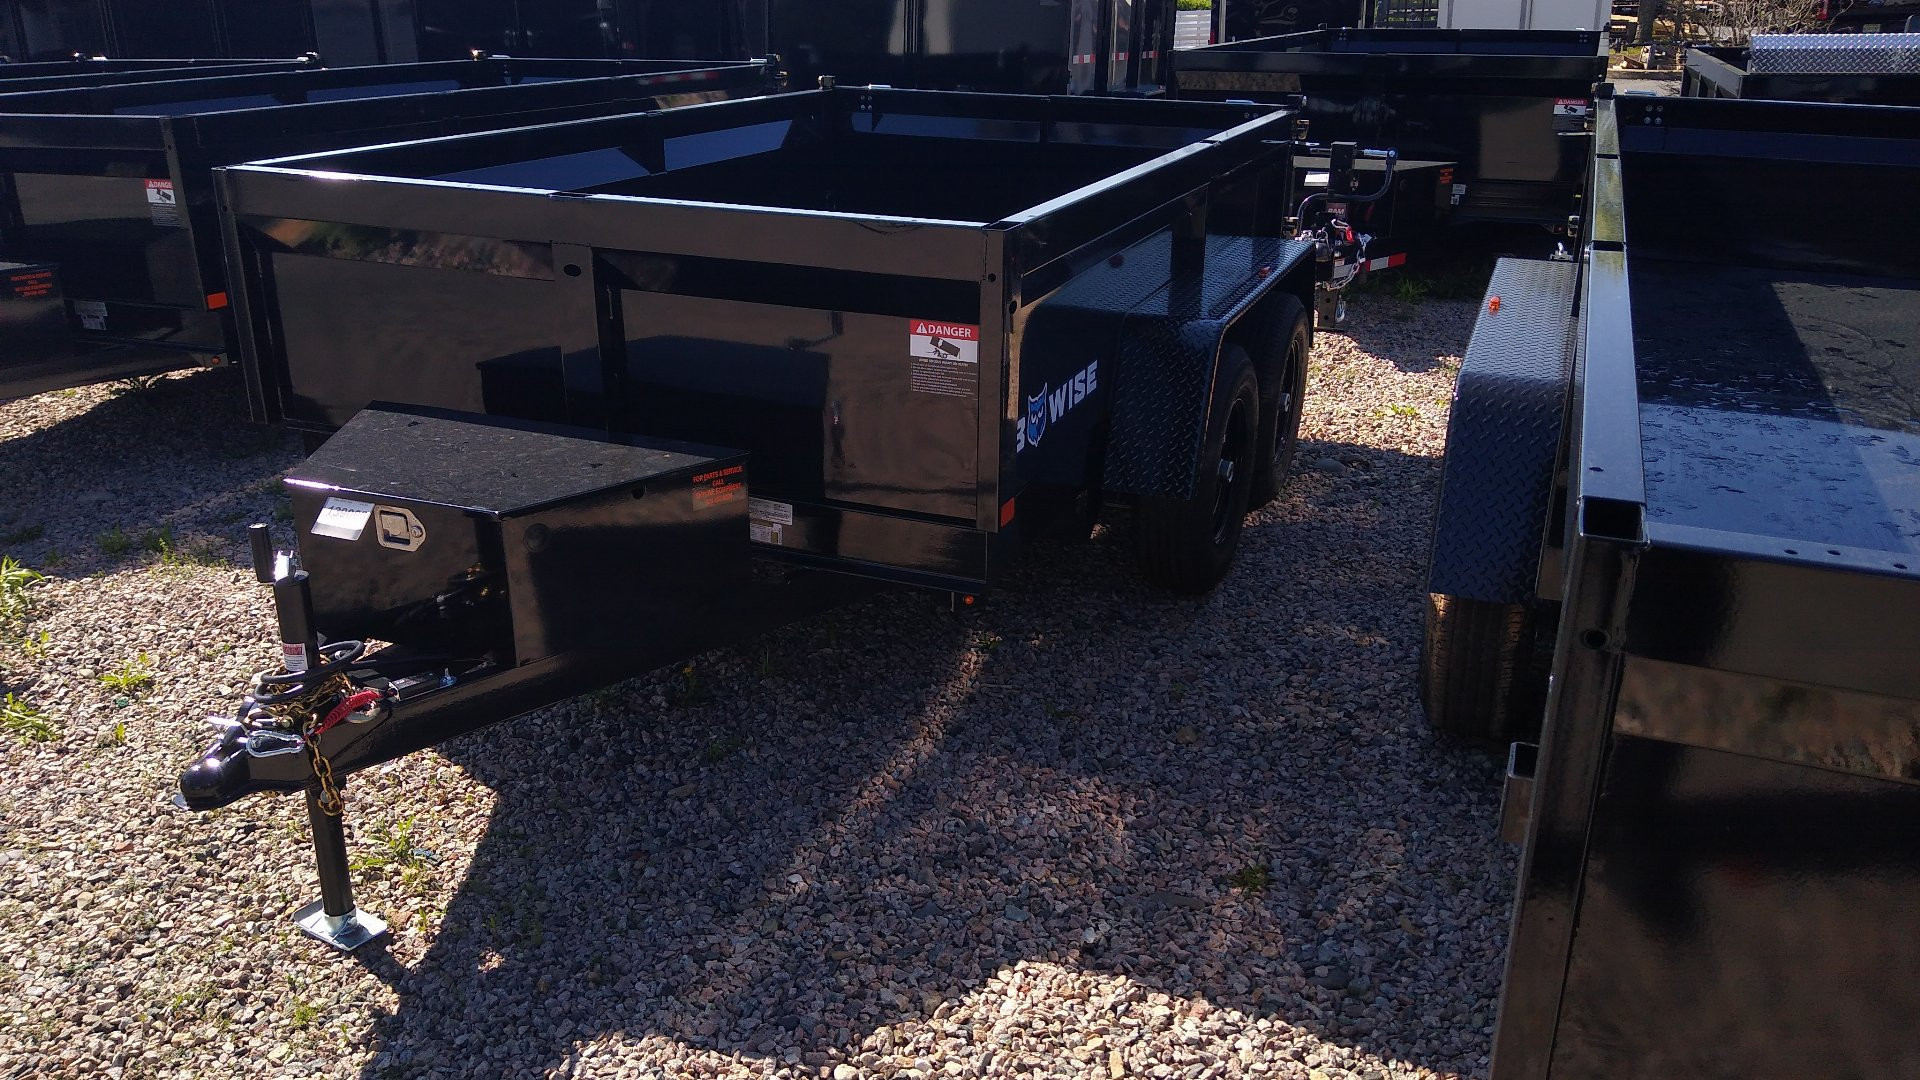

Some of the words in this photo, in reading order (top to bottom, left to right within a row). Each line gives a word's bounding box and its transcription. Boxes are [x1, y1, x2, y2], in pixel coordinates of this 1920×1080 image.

[153, 180, 173, 188] DANGE
[928, 324, 971, 338] DANGER
[692, 475, 703, 483] FOR
[704, 471, 719, 481] PARTS
[723, 465, 743, 476] SERVICE
[712, 478, 724, 487] CALL
